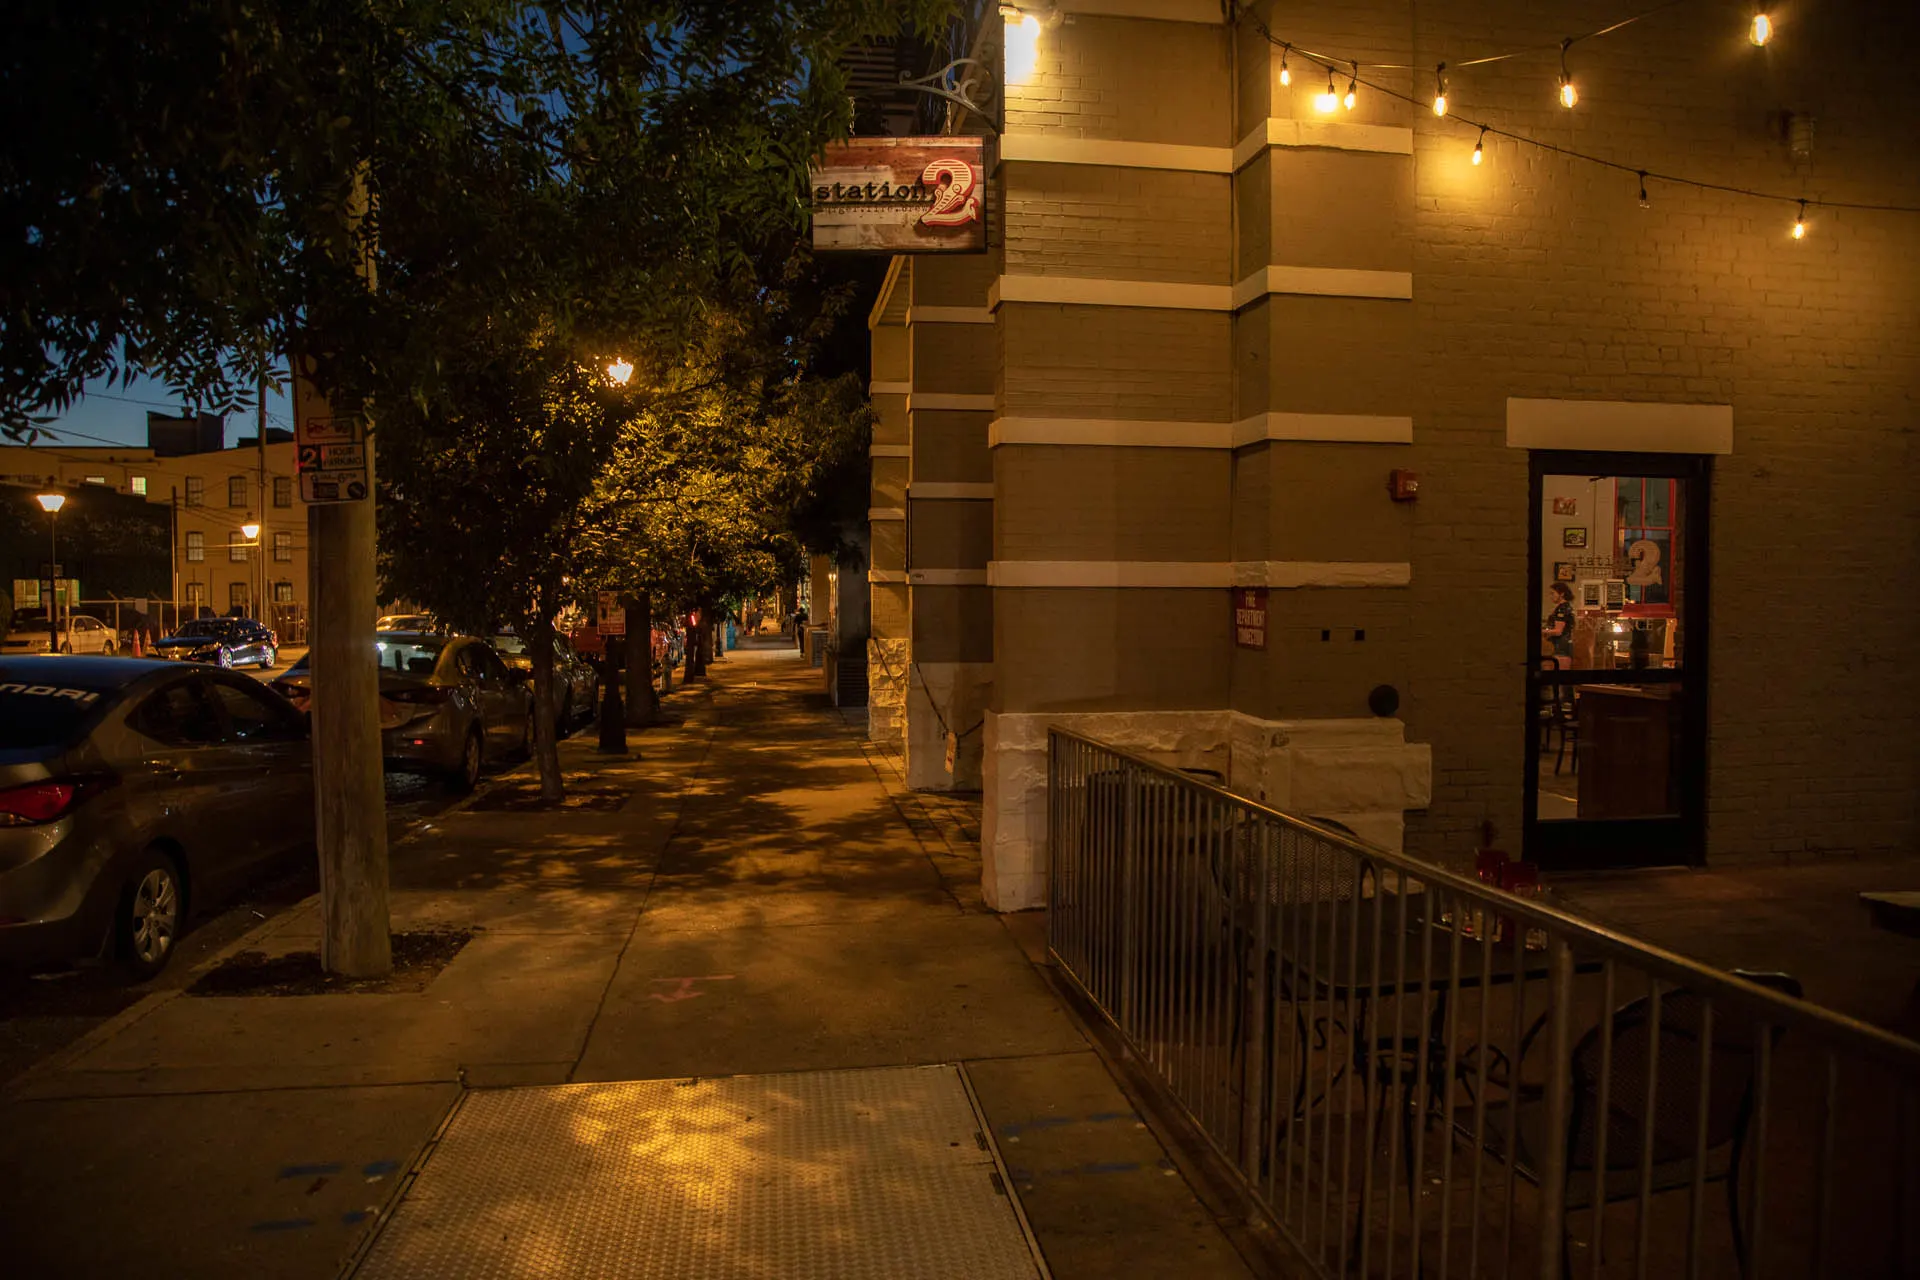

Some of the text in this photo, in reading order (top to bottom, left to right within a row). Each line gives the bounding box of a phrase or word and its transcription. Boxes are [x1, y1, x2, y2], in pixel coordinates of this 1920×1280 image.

[816, 158, 979, 227] station 2
[303, 447, 317, 468] 2
[329, 447, 355, 456] HOUR
